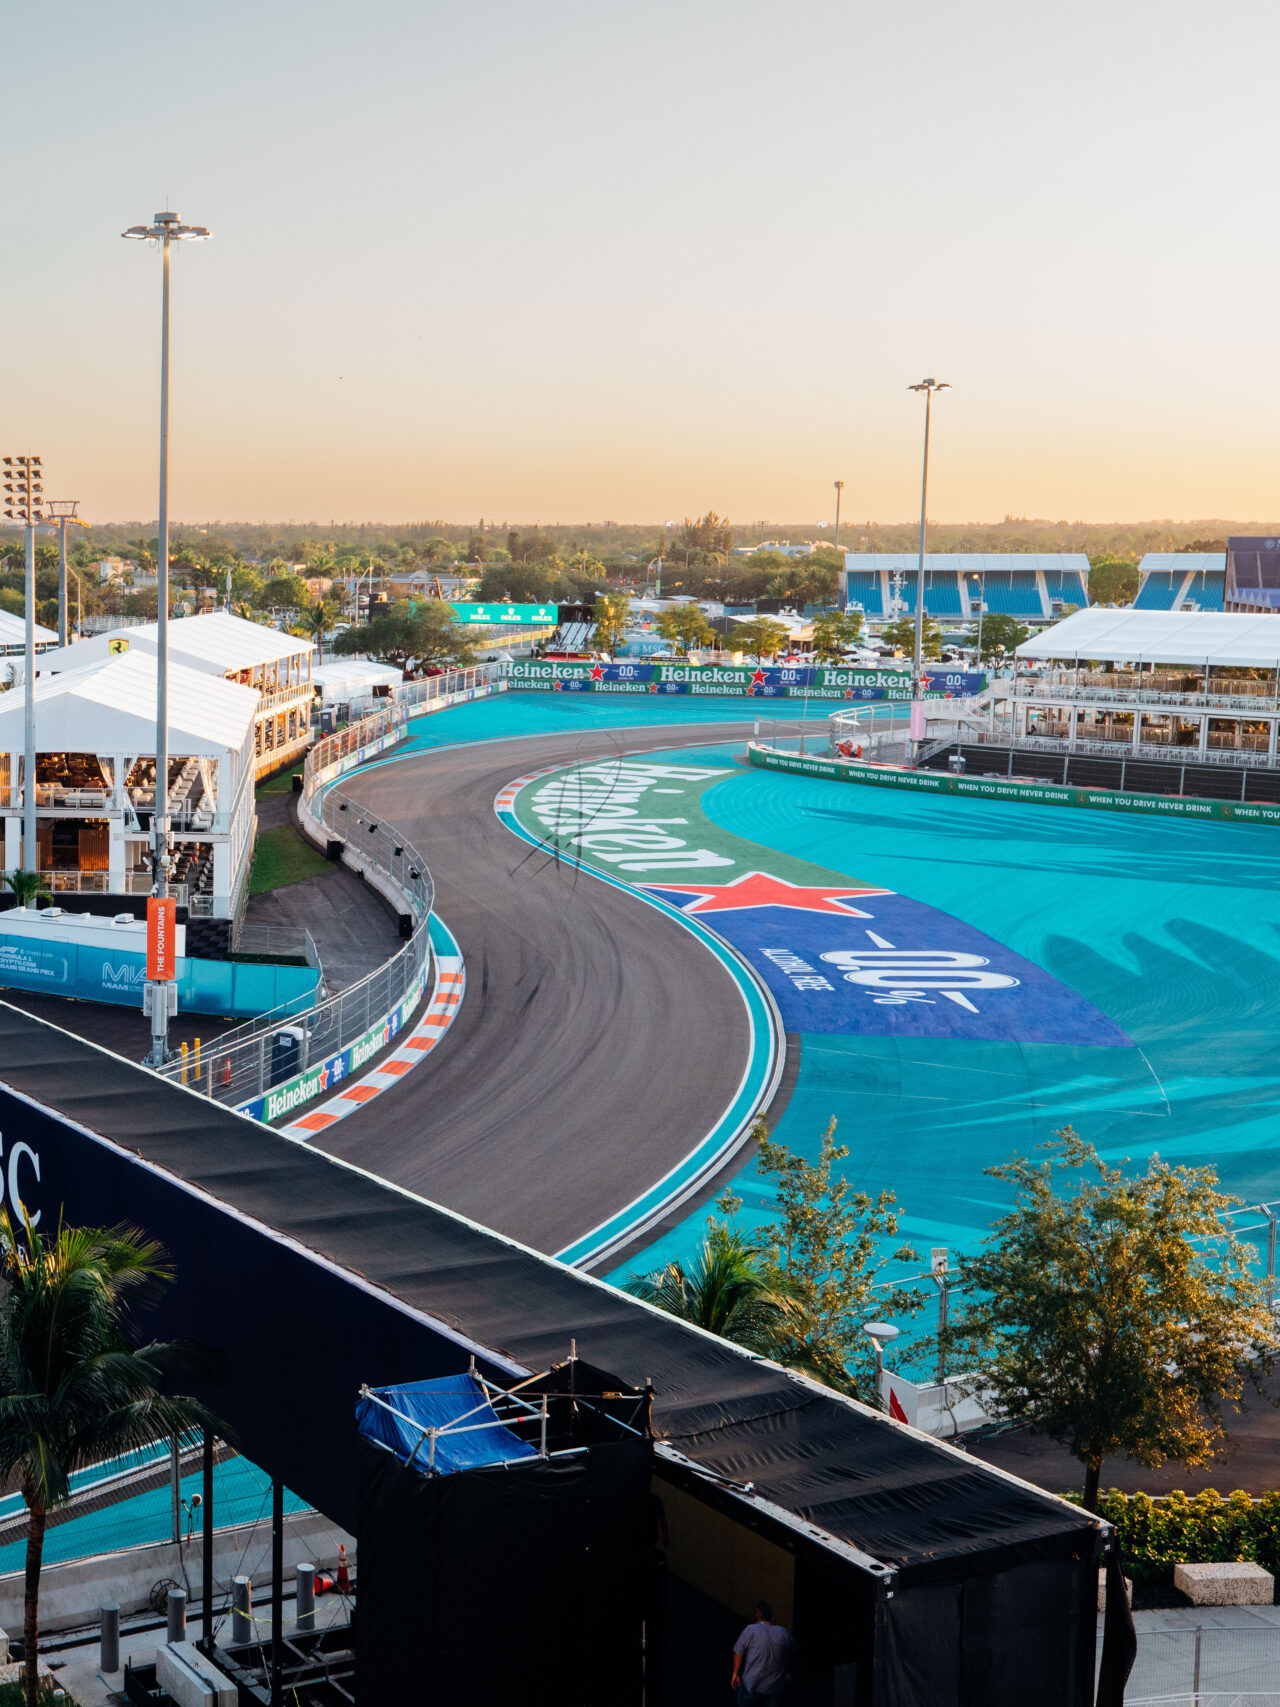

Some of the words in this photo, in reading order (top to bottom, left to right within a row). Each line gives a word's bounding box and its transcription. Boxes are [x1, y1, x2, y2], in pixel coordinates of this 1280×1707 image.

[500, 662, 584, 679] Heineken
[660, 667, 746, 683] Heineken
[507, 680, 550, 690] eineken
[823, 670, 911, 688] Heineken
[595, 682, 646, 693] Heineken
[691, 684, 743, 695] Heineken
[789, 687, 841, 698] Heineken
[888, 689, 940, 700] Heinken
[789, 760, 802, 768] DRIVE
[803, 763, 818, 771] NEVER
[849, 770, 865, 778] WHEN
[880, 774, 897, 782] DRIVE
[898, 777, 917, 785] NEVER
[919, 779, 939, 787] DRINK
[958, 783, 978, 791] WHEN
[980, 785, 995, 793] YOU
[997, 787, 1018, 795] DRIVE
[1020, 789, 1043, 798] NEVER
[1045, 791, 1069, 800] DRINK
[1089, 795, 1112, 804] WHEN
[1114, 797, 1131, 806] YOU
[1133, 799, 1156, 808] DRIVE
[1158, 802, 1184, 811] NEVER
[1186, 804, 1212, 813] DRINK
[531, 761, 735, 871] Heineken
[1234, 807, 1260, 817] WHEN
[1262, 809, 1280, 819] YOU
[157, 906, 165, 954] FOUNTAINS
[759, 948, 817, 974] ALCOHOL
[788, 975, 835, 991] FREE
[102, 981, 129, 990] MIAMI
[268, 1076, 318, 1120] Heineken
